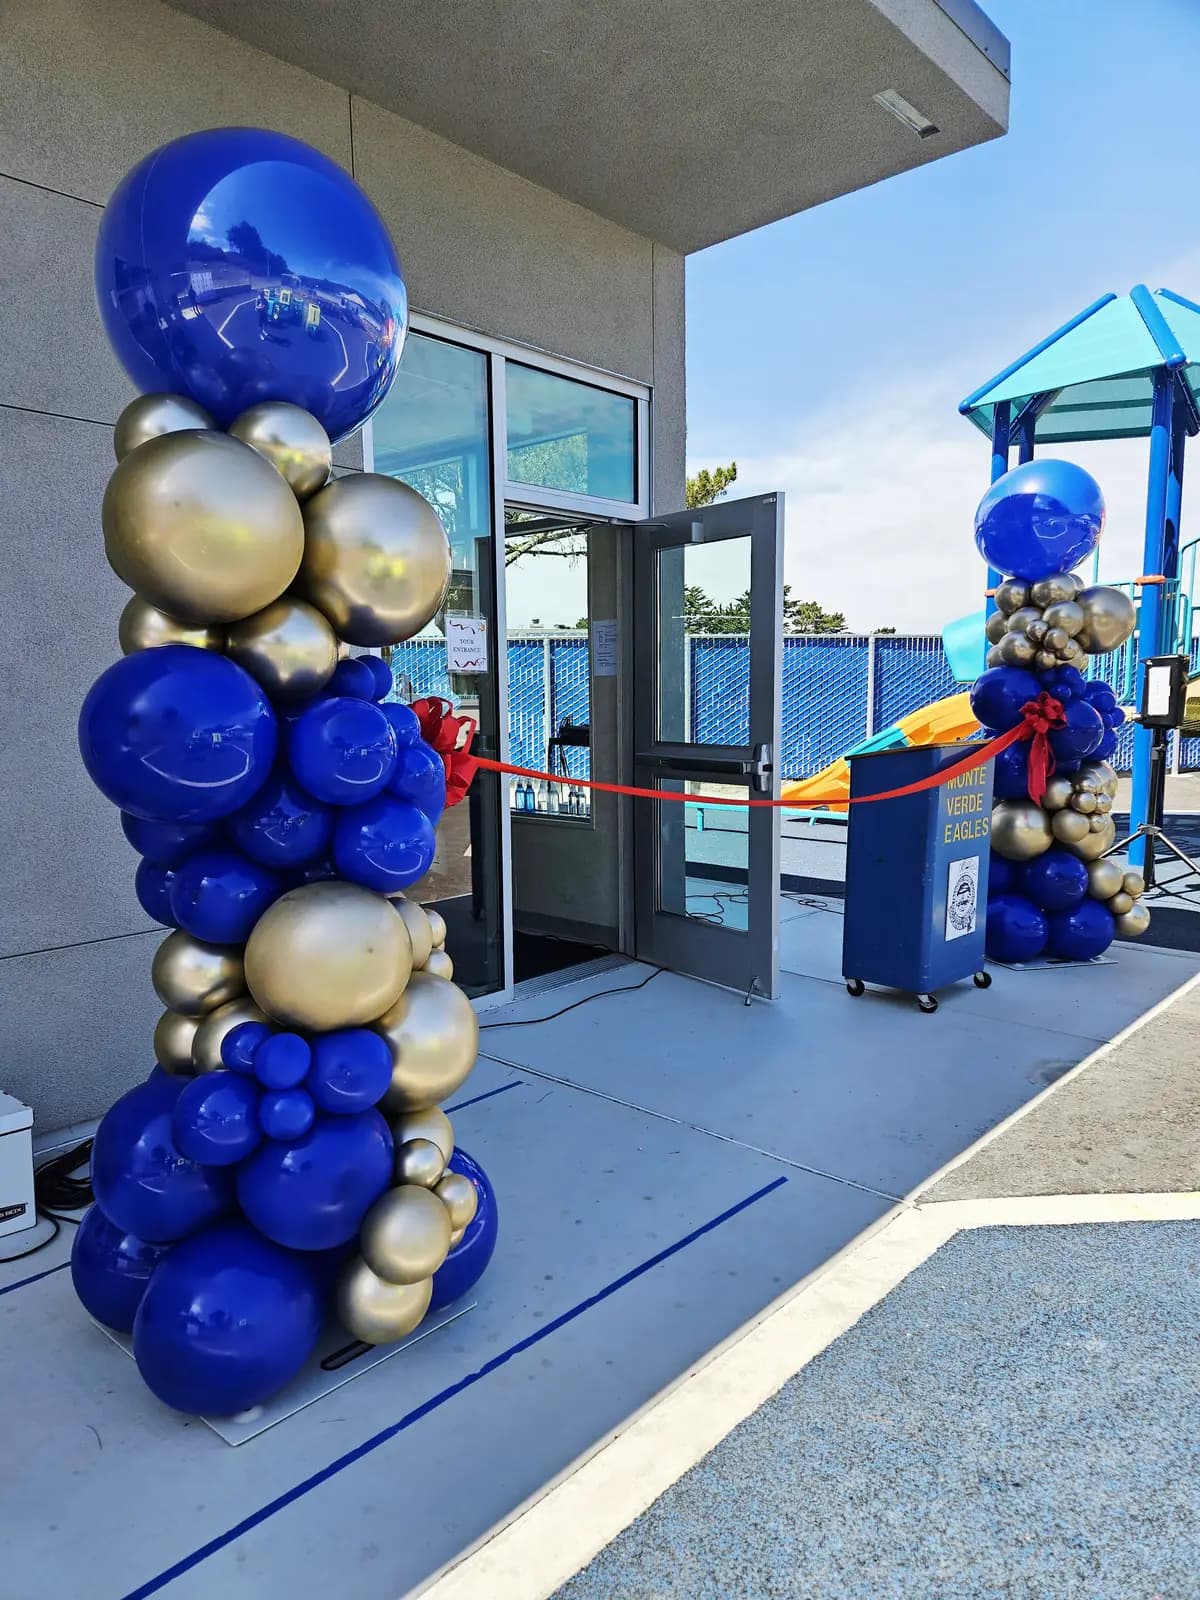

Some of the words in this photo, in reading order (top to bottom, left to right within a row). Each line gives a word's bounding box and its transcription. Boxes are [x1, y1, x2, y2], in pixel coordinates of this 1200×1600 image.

[947, 766, 987, 790] MONTE
[946, 792, 984, 817] VERDE
[943, 817, 989, 844] EAGLES
